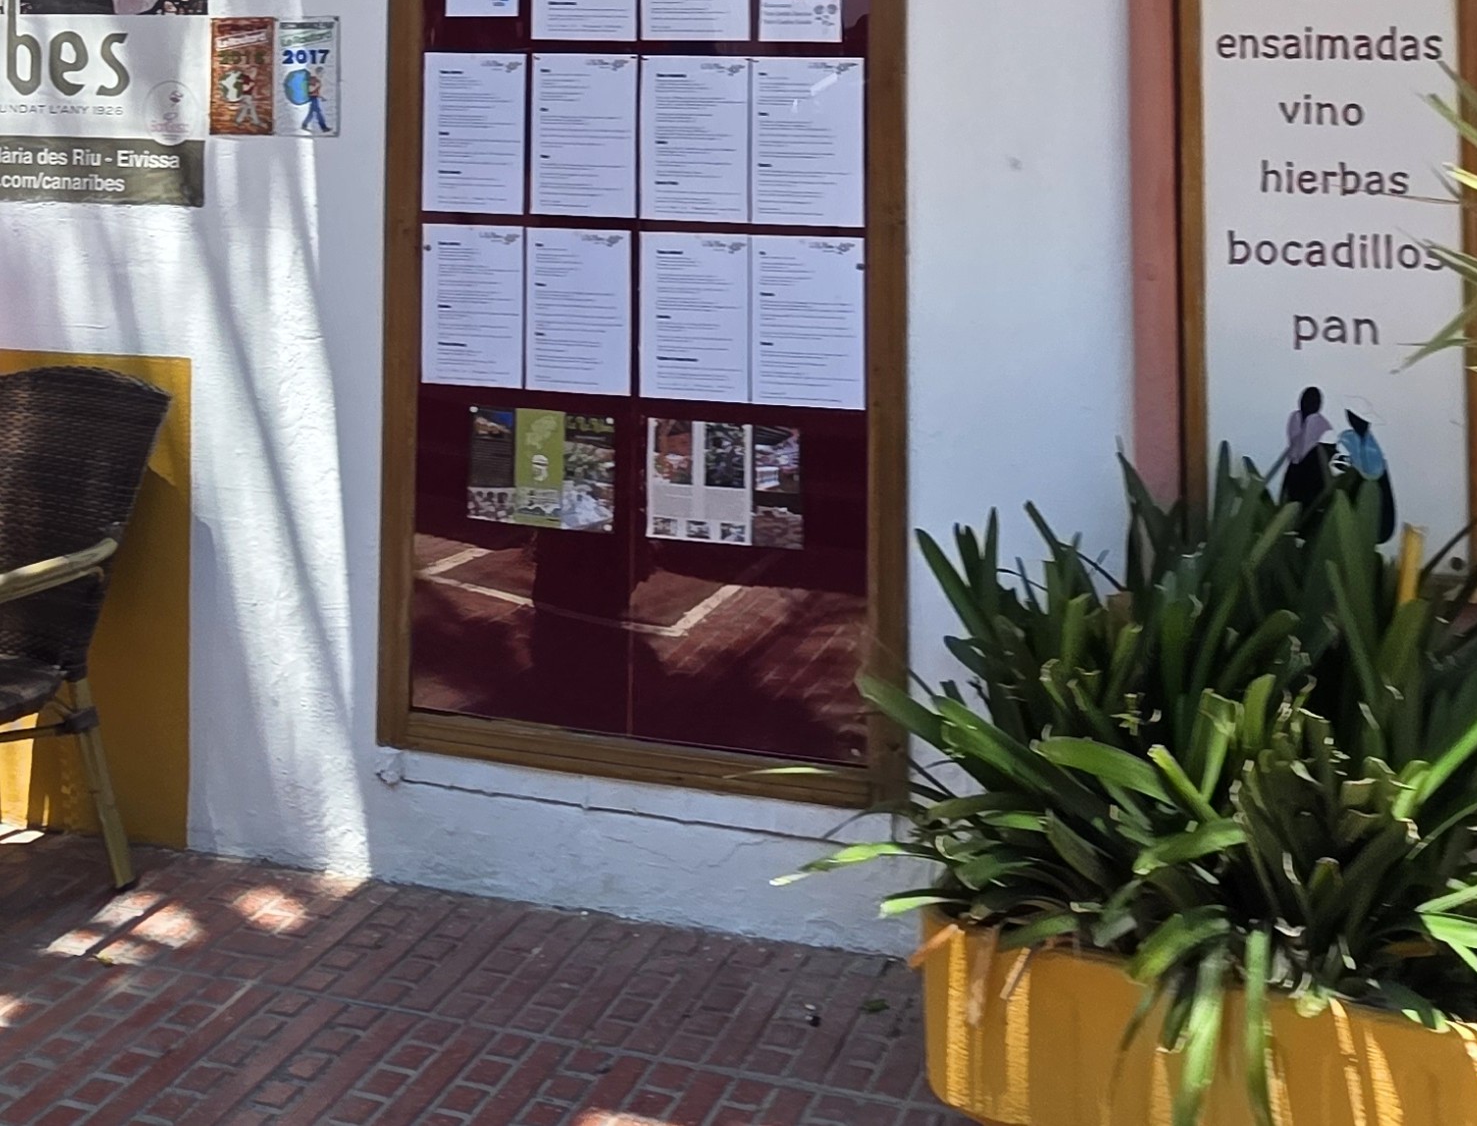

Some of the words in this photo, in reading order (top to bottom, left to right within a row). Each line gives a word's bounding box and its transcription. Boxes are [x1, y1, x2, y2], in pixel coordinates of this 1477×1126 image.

[282, 49, 330, 64] 2017
[1216, 26, 1443, 61] ensaimadas
[92, 106, 124, 115] 1926
[1278, 94, 1365, 126] vino
[37, 148, 68, 165] des
[72, 149, 101, 166] Riu
[116, 149, 180, 168] Eivissa
[1260, 160, 1410, 196] hierbas
[1226, 230, 1448, 271] bocadillos
[1292, 314, 1379, 350] pan
